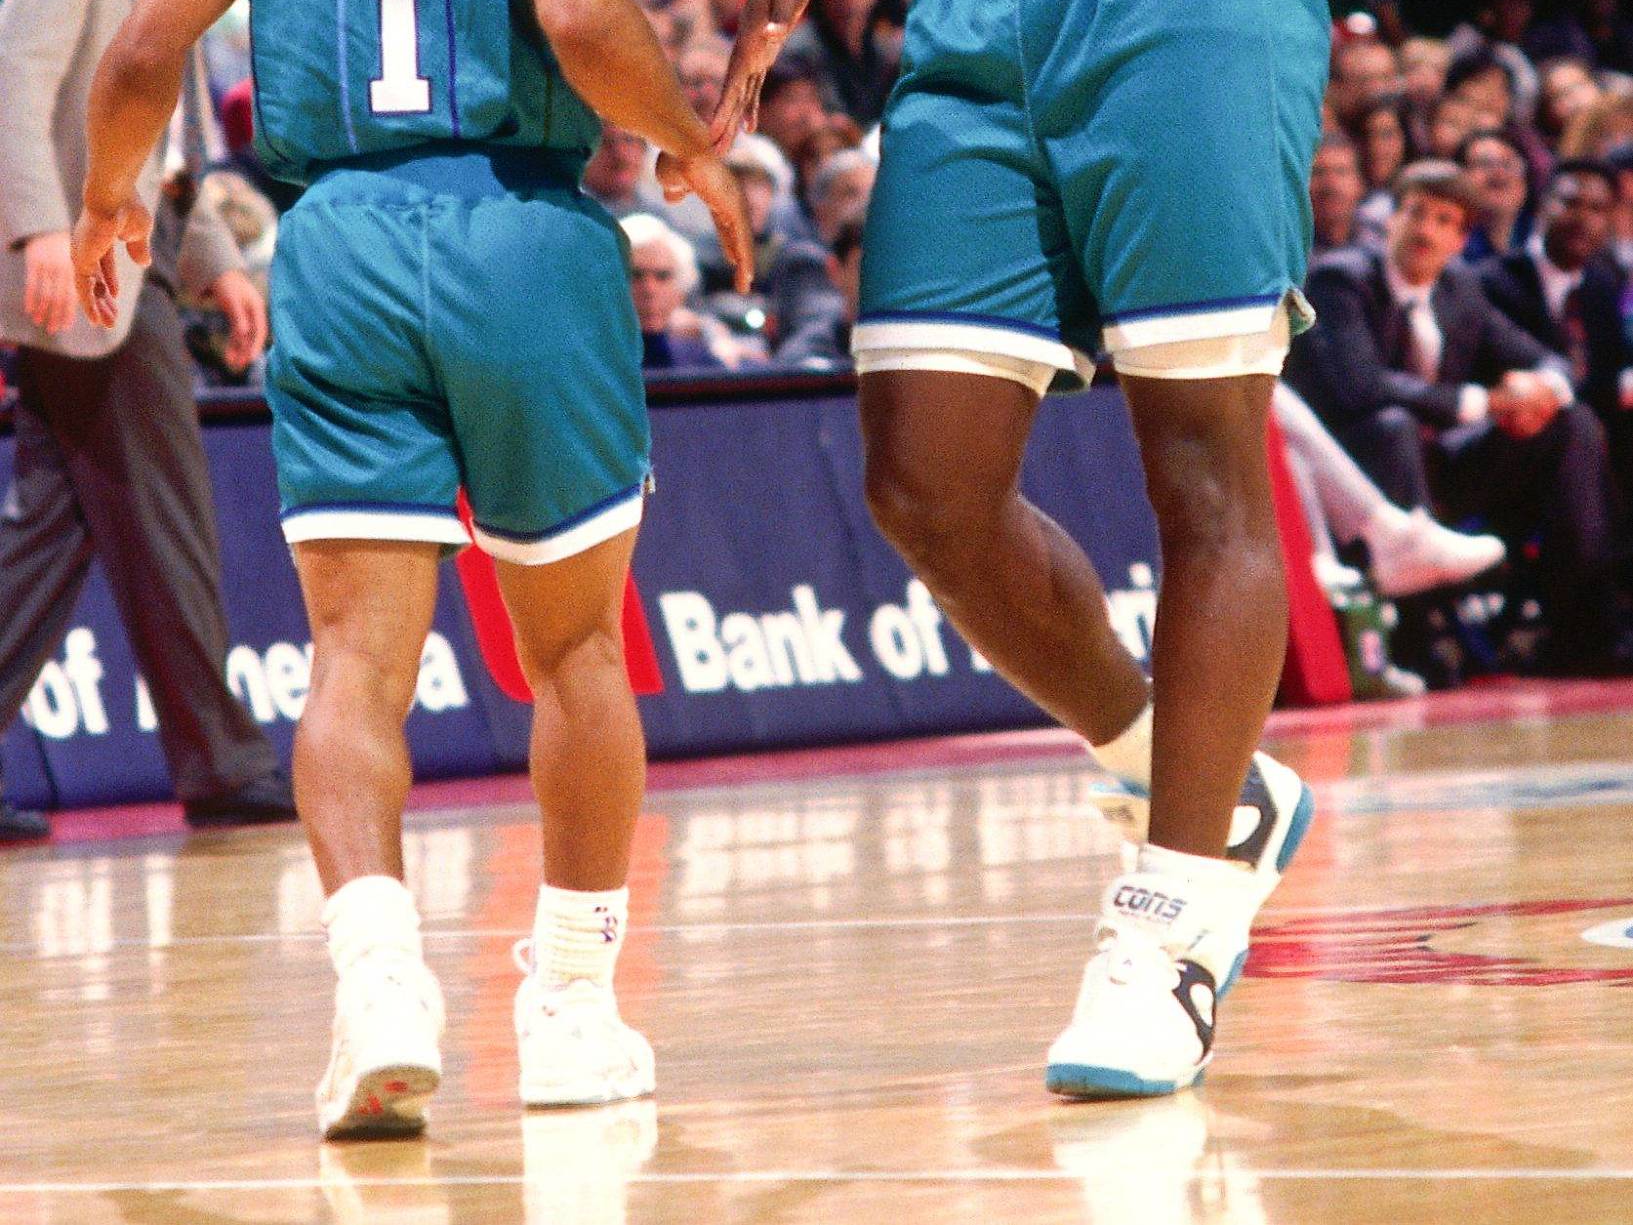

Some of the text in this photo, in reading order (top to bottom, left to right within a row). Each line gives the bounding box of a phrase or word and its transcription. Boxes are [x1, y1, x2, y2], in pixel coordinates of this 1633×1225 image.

[30, 627, 108, 738] of
[659, 584, 863, 694] Bank
[870, 577, 950, 680] of
